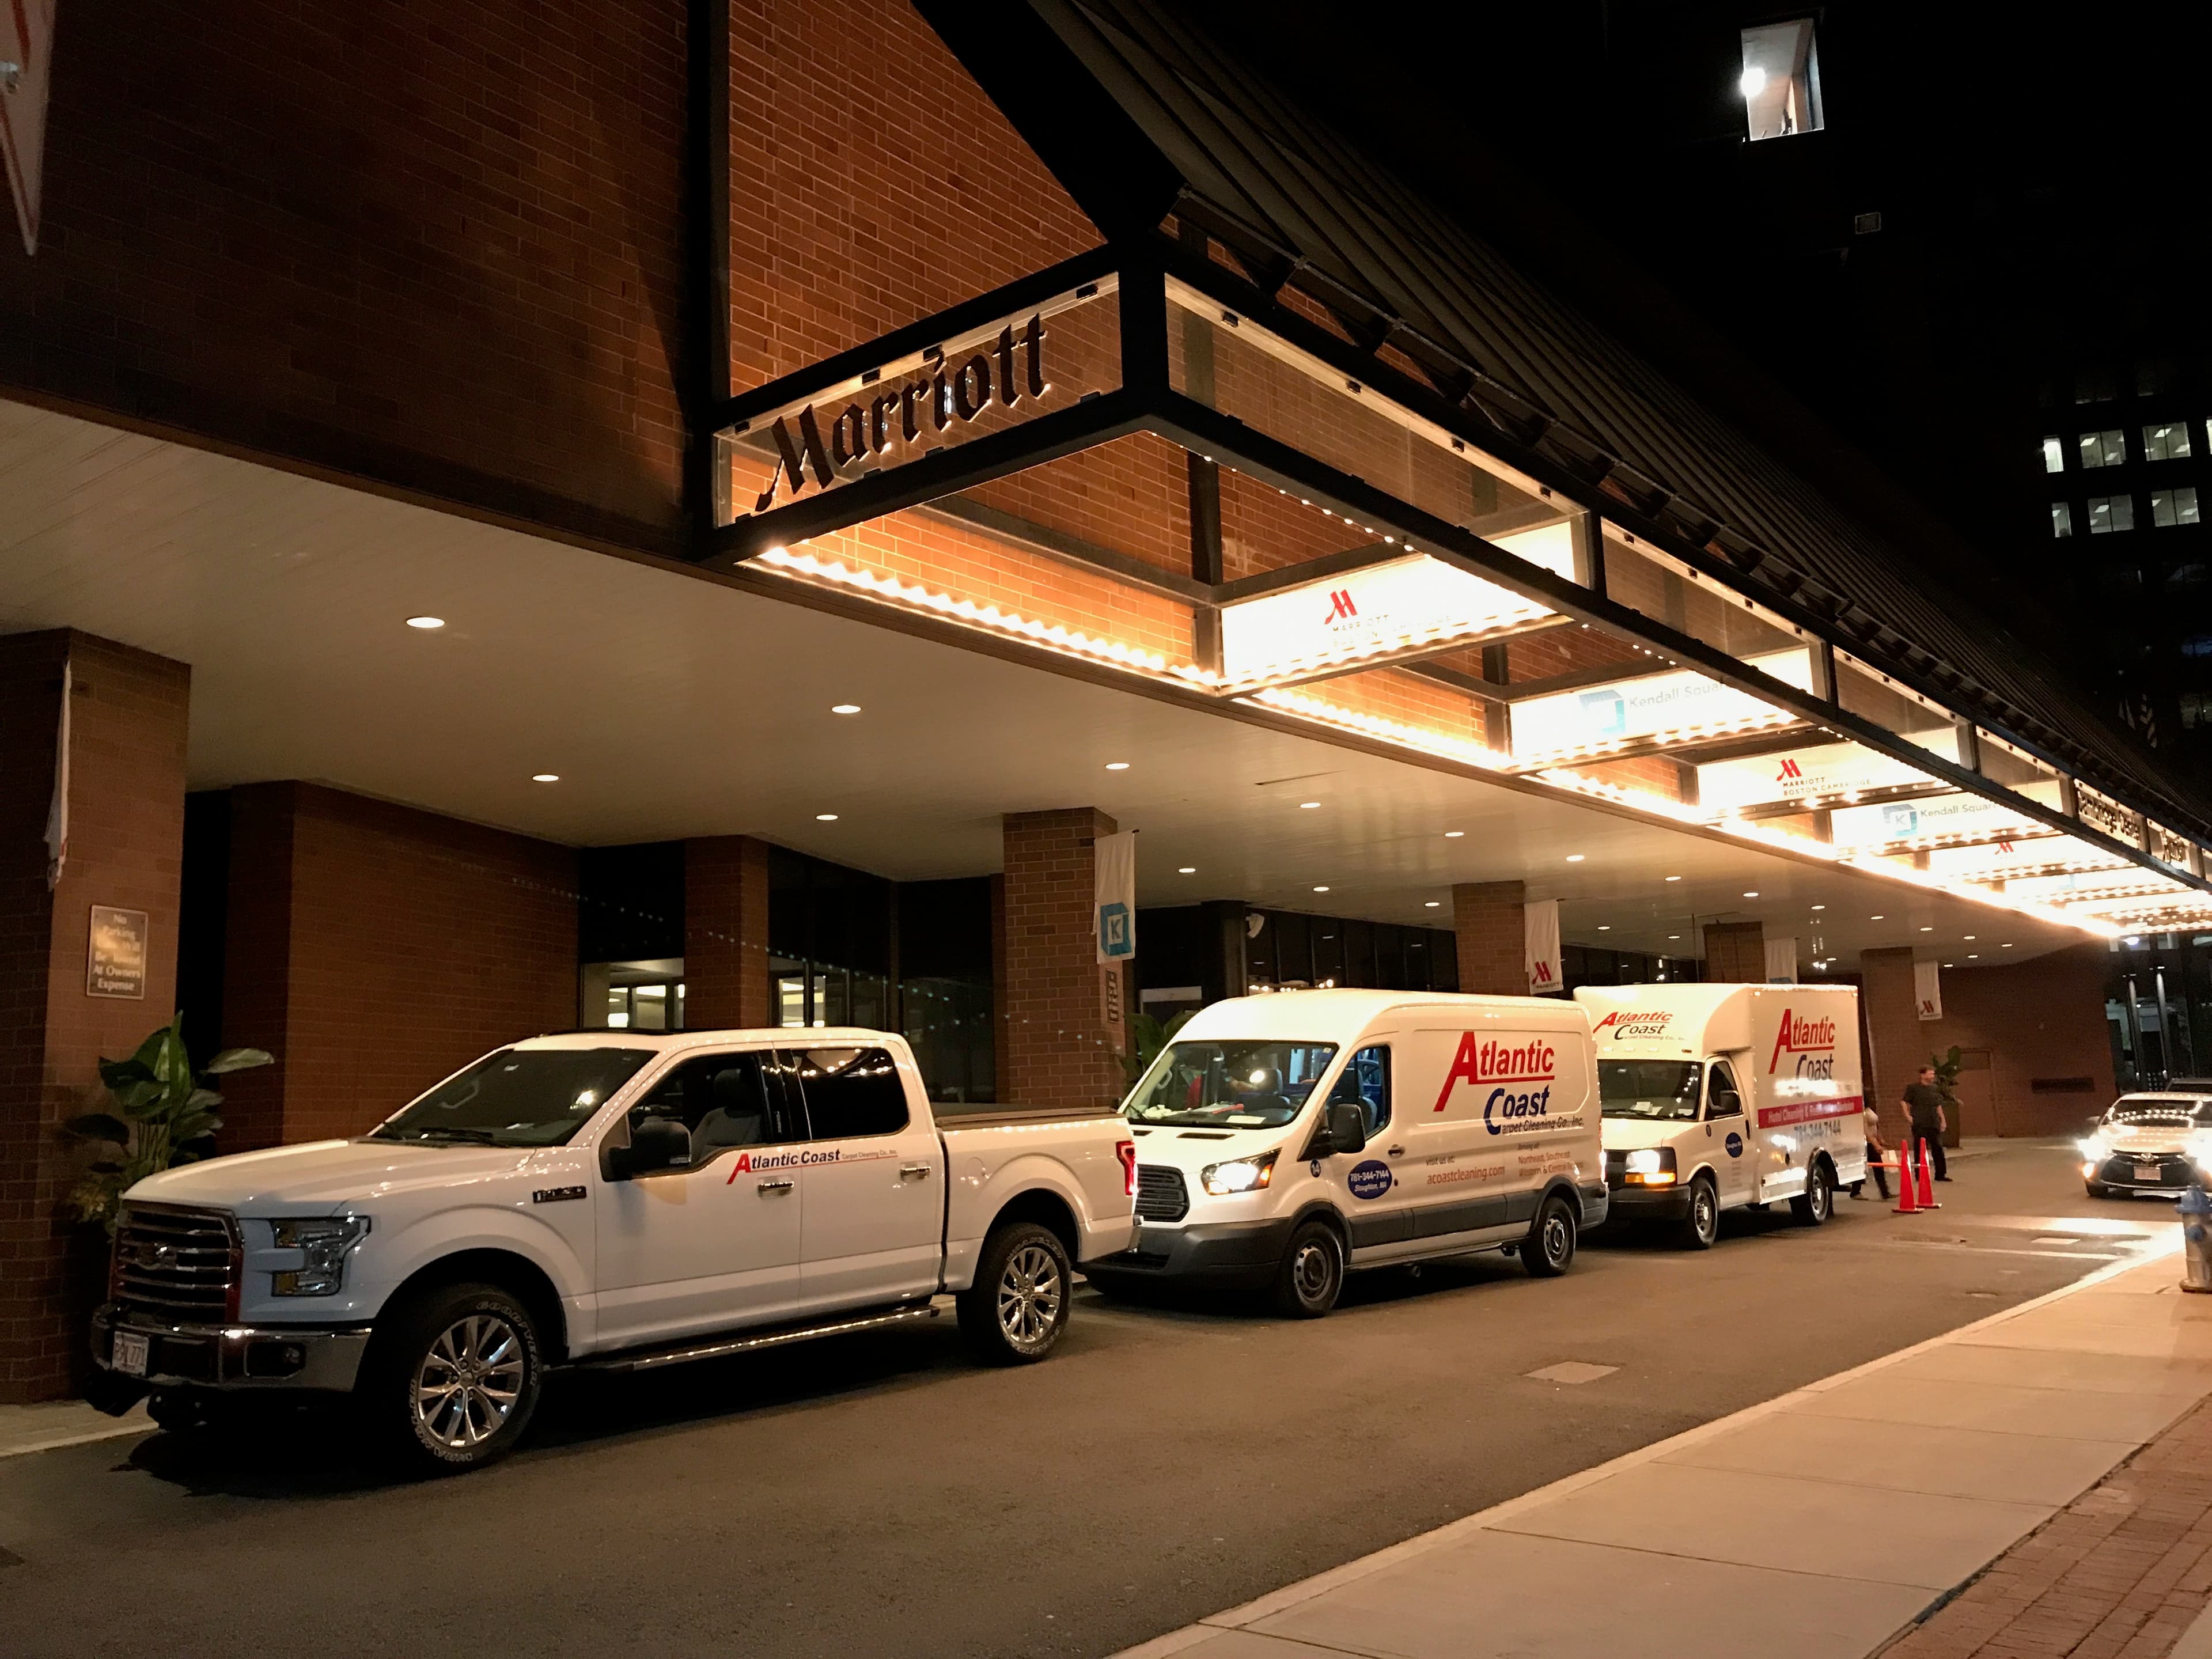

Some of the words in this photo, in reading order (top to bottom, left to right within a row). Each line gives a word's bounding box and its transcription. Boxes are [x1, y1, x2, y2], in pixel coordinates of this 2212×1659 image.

[755, 313, 1050, 512] Marriott
[1333, 615, 1388, 631] MARROTT
[1630, 688, 1679, 707] Kendall
[1684, 682, 1723, 698] Squar
[1783, 777, 1825, 787] MARRIOTT
[1784, 787, 1817, 796] BOSTON
[1921, 806, 1959, 817] Kendall
[113, 914, 127, 925] No
[103, 925, 136, 941] Parking
[93, 964, 103, 975] At
[106, 965, 141, 978] Owners
[98, 978, 134, 991] Expense
[1593, 1012, 1673, 1033] Atlantic
[1614, 1024, 1665, 1040] Coast
[1768, 1009, 1835, 1074] Atlantic
[1433, 1031, 1554, 1112] Atlantic
[1483, 1085, 1550, 1135] Coast
[1523, 1118, 1555, 1131] Cleaning
[726, 1153, 798, 1184] Atlantic
[801, 1149, 840, 1164] Coast
[1310, 1162, 1320, 1175] 14
[1543, 1165, 1547, 1173] &
[1350, 1170, 1389, 1182] 781-344-7144
[1427, 1166, 1505, 1184] acoastcleaning.com
[476, 1301, 538, 1386] GOODYEAR
